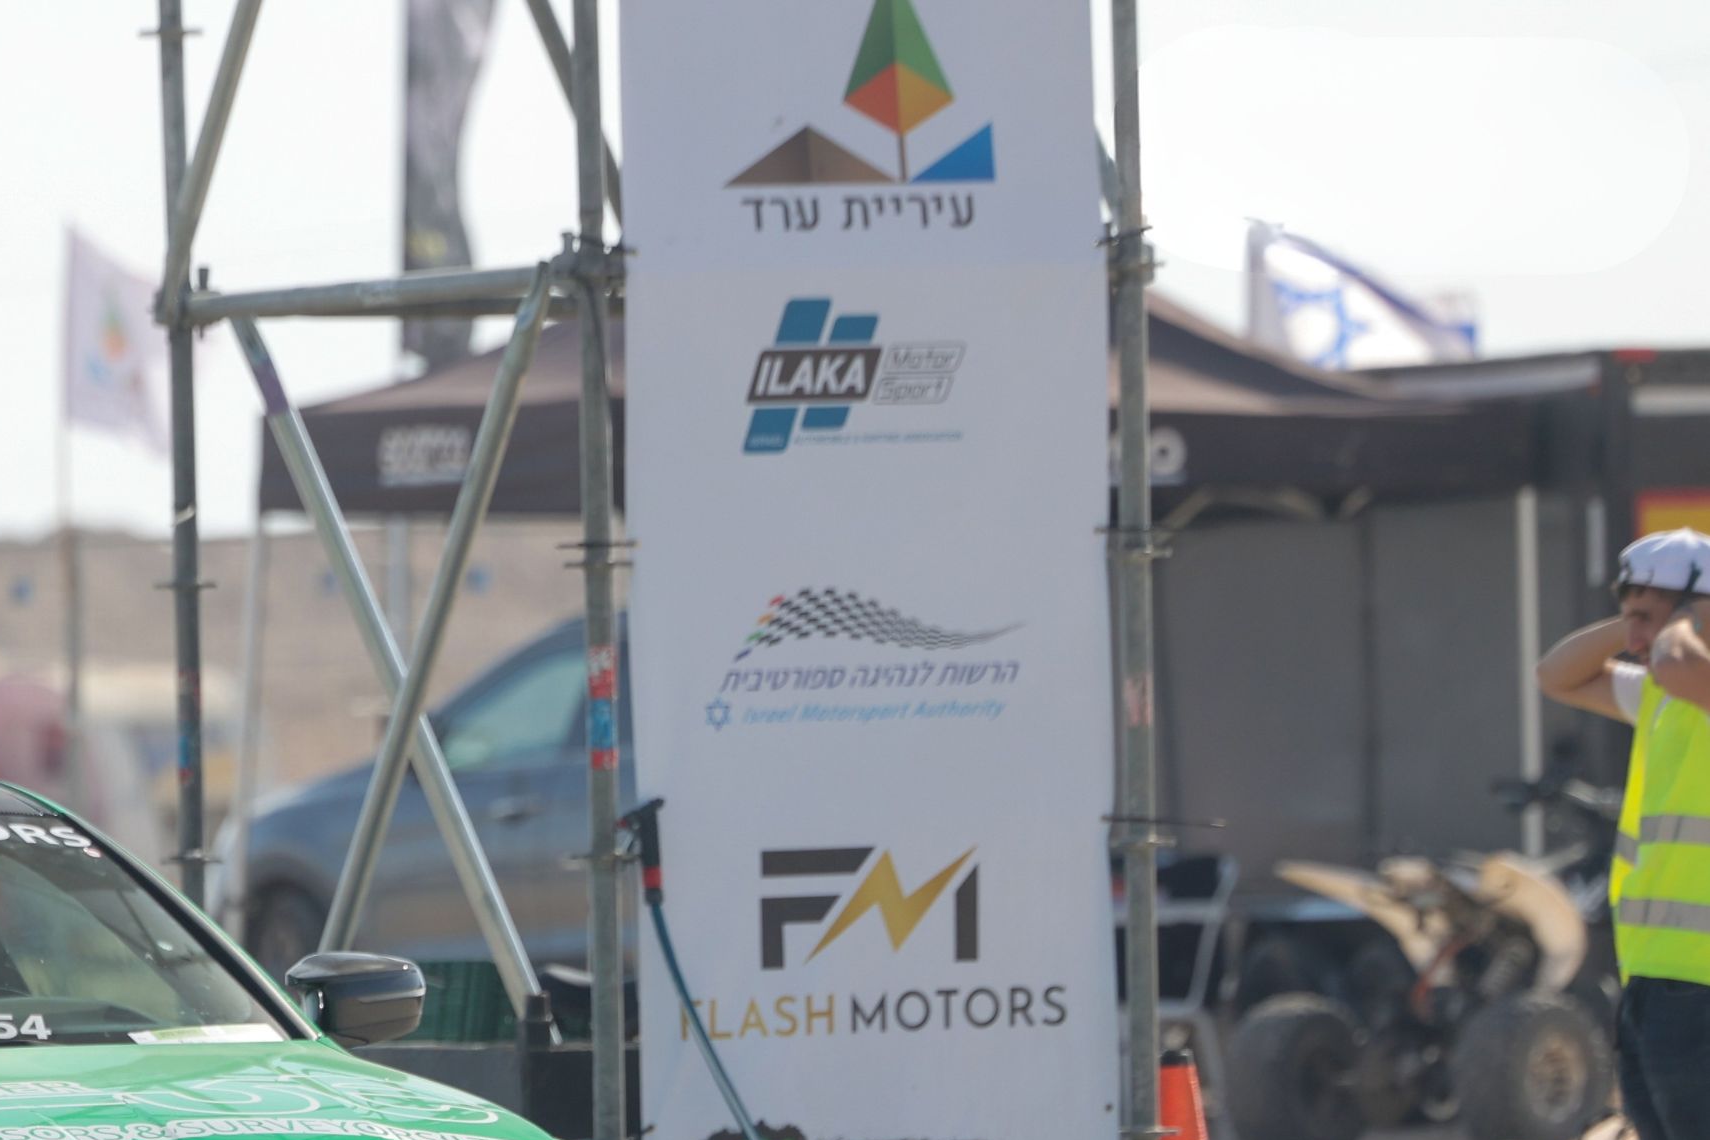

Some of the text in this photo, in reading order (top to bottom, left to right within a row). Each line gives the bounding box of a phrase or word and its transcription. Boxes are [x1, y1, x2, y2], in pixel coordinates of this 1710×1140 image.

[740, 193, 975, 233] עיריית ערד
[754, 353, 868, 396] ILAKA
[849, 660, 935, 689] לנהיגה
[937, 659, 1021, 687] הרשות
[850, 986, 1068, 1034] MOTORS
